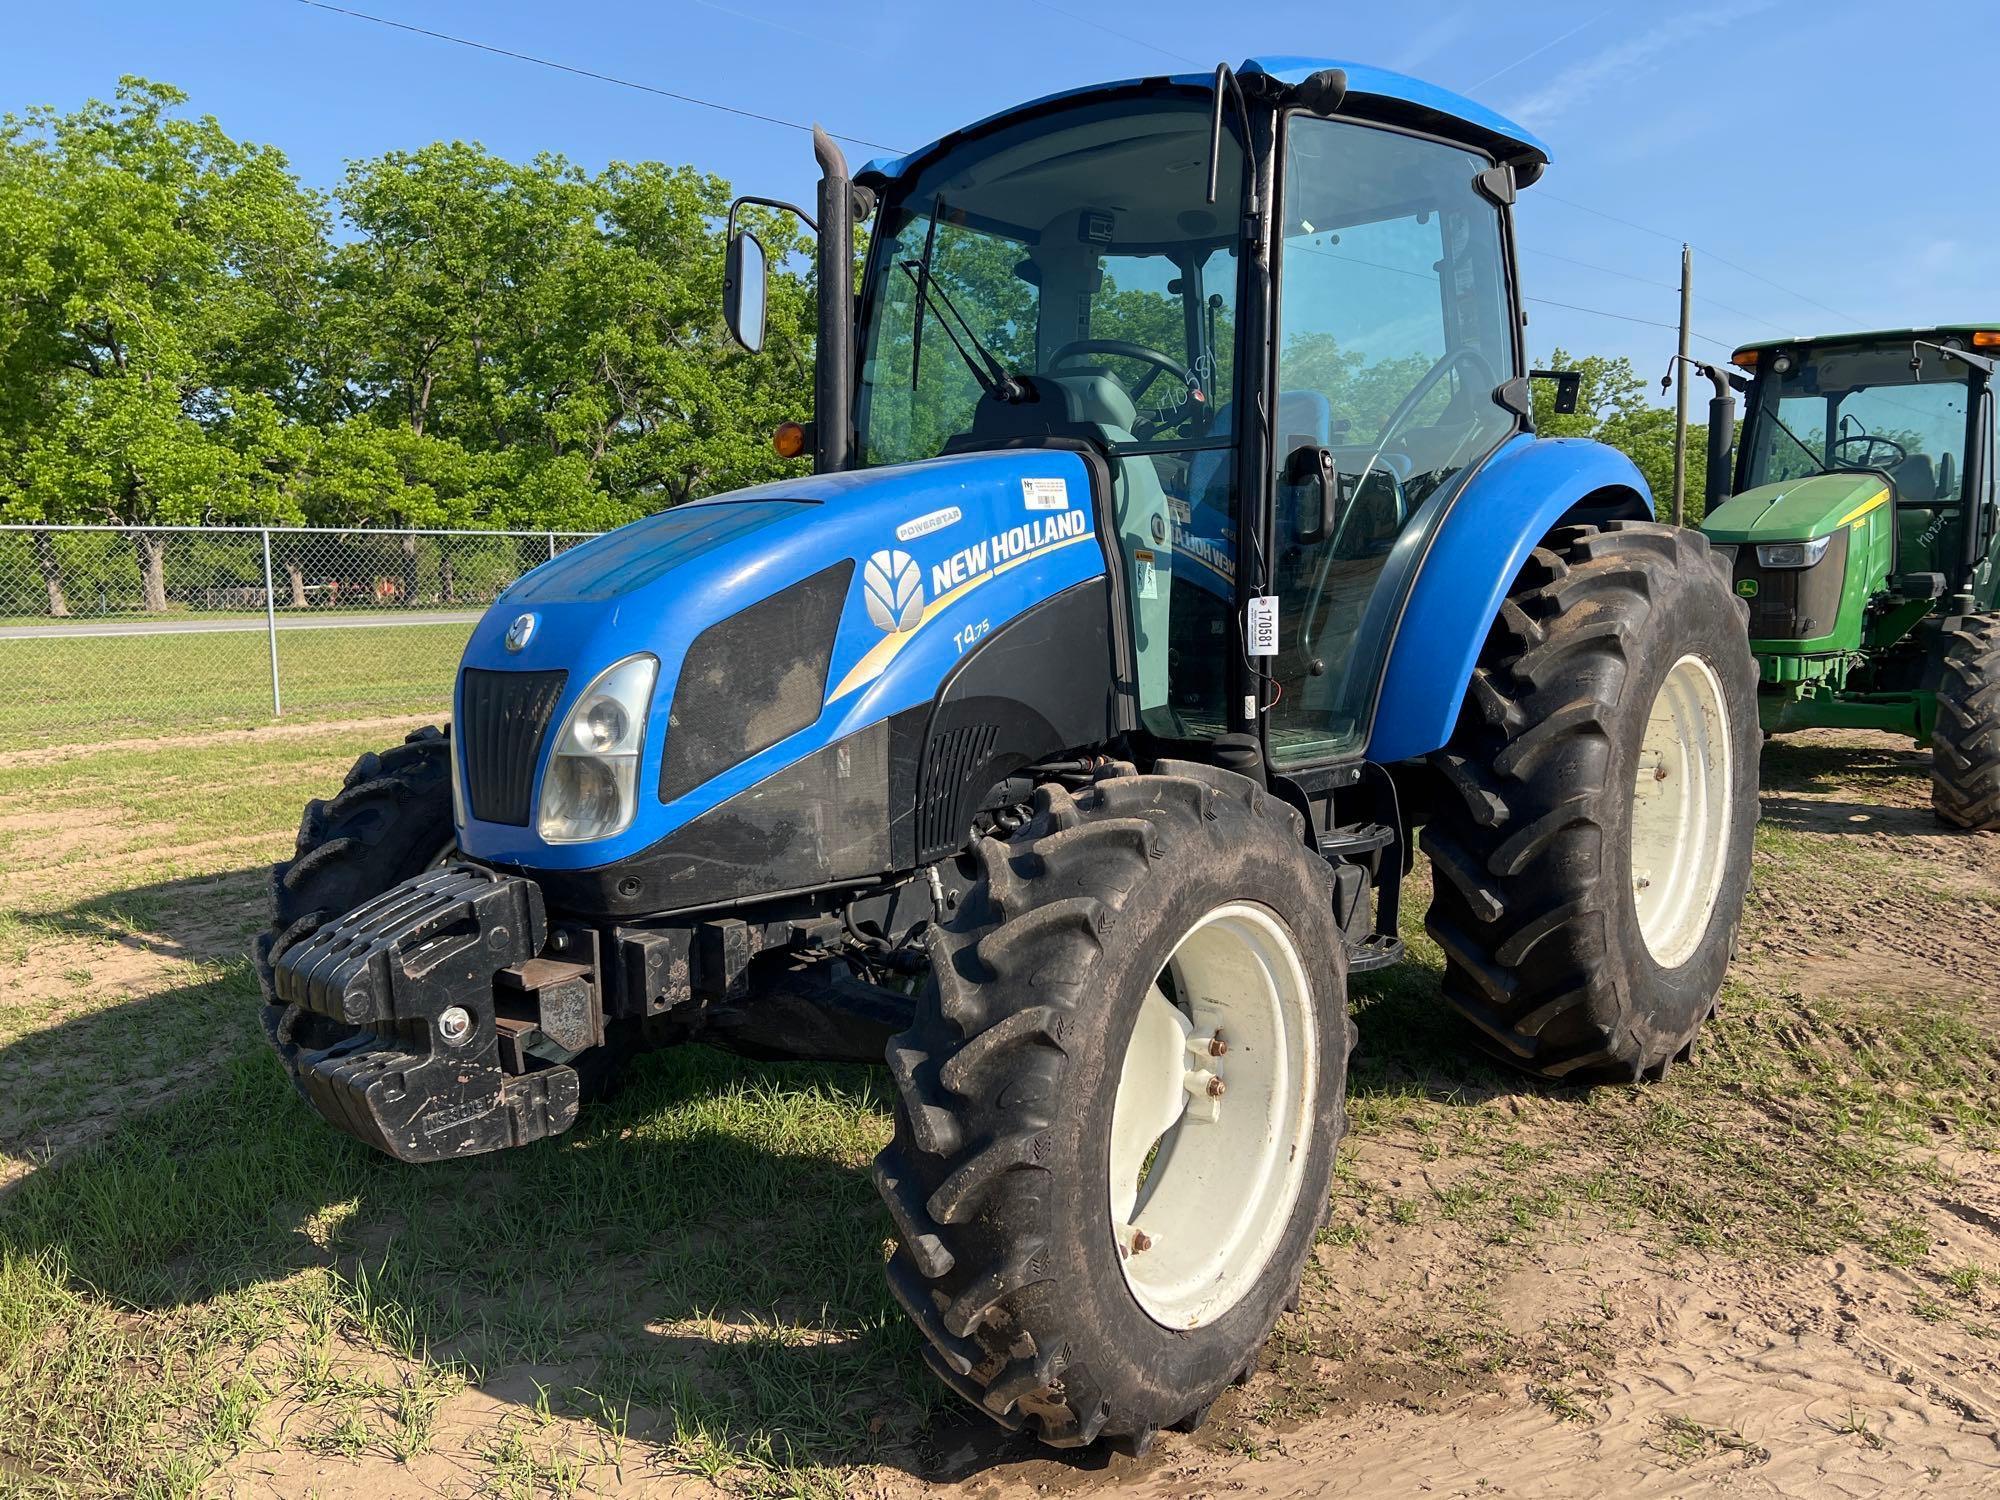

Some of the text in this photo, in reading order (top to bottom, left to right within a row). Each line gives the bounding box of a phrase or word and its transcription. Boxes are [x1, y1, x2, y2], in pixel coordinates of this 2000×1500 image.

[1156, 345, 1217, 424] 170581
[900, 509, 960, 539] POWERSTAR
[932, 509, 1086, 596] NEW HOLLAND
[1258, 609, 1273, 647] 170581
